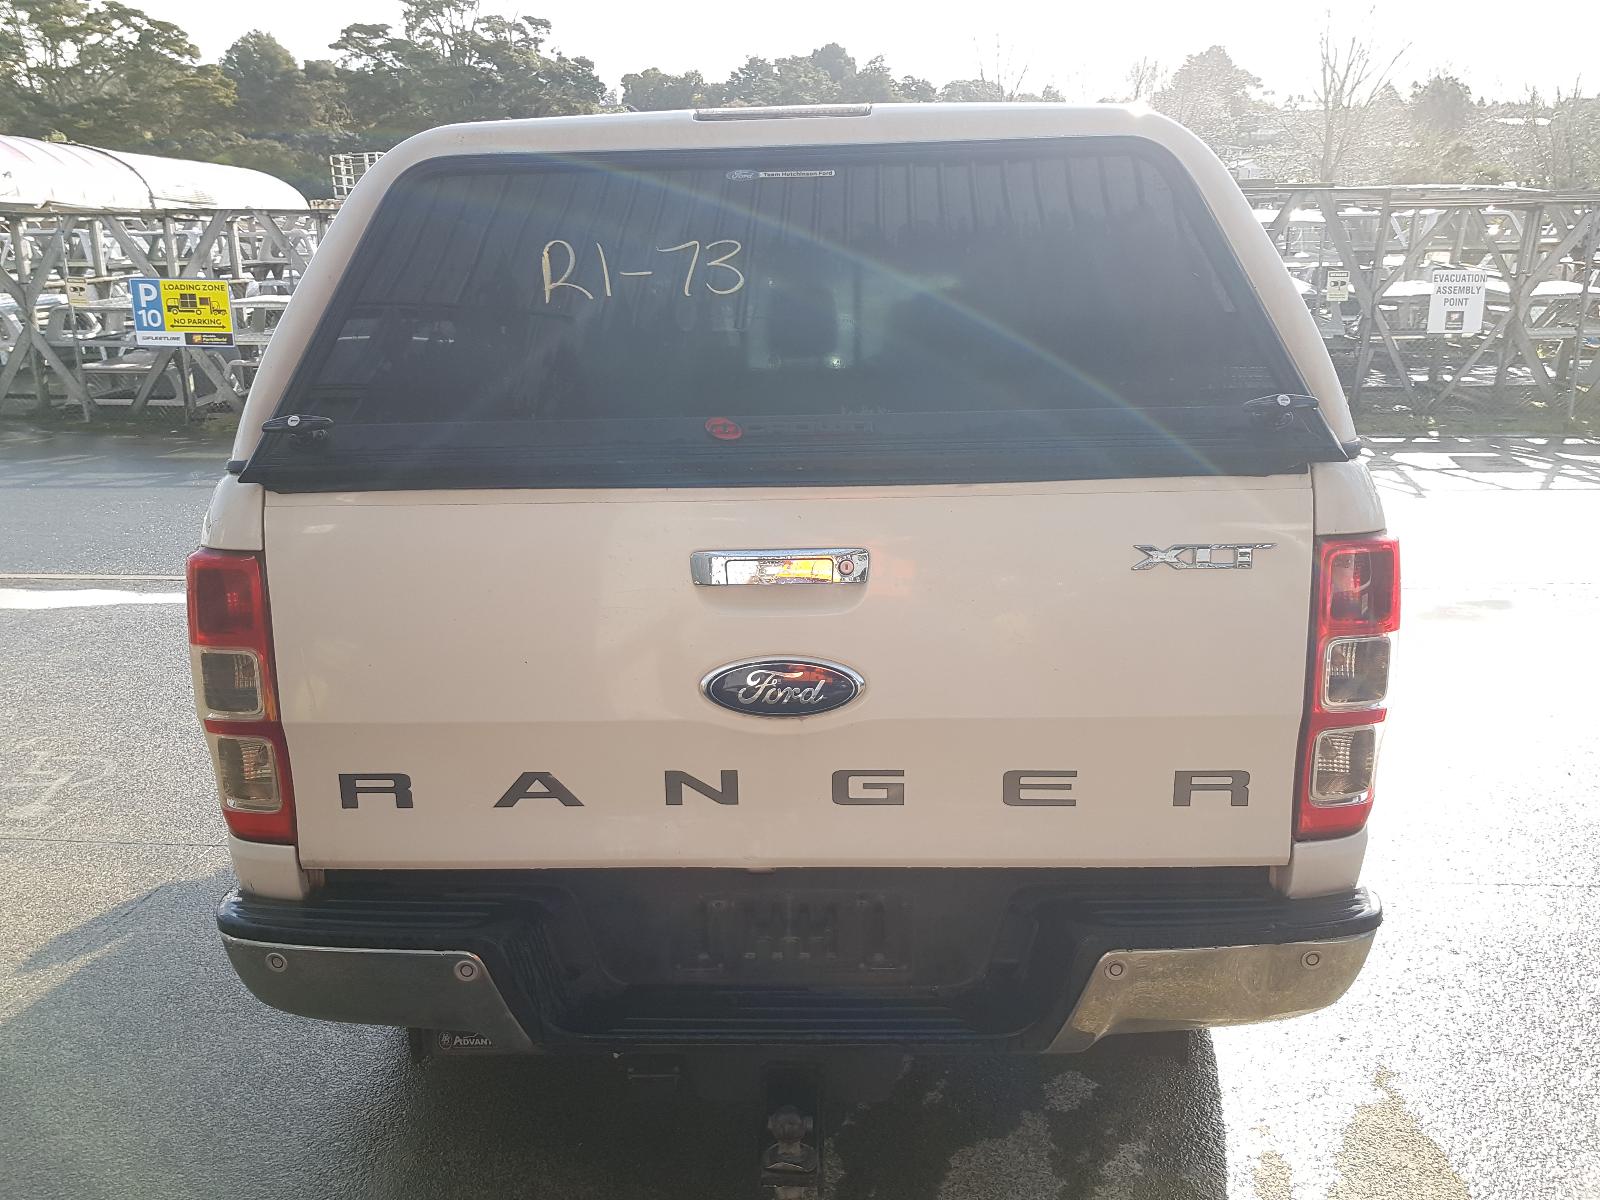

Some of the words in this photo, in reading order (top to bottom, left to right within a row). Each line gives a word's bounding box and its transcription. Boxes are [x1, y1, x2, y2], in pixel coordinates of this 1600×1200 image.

[541, 239, 745, 304] R1-73
[1433, 273, 1486, 283] EVACUATION
[138, 283, 158, 308] P
[163, 283, 201, 292] LOADING
[202, 284, 226, 292] ZONE
[1435, 286, 1482, 295] ASSEMBLY
[1443, 298, 1470, 307] POINT
[138, 309, 162, 328] 10
[187, 318, 222, 326] PARKING
[1131, 543, 1276, 571] XLT
[737, 669, 826, 705] Ford
[337, 769, 1251, 809] RANGER
